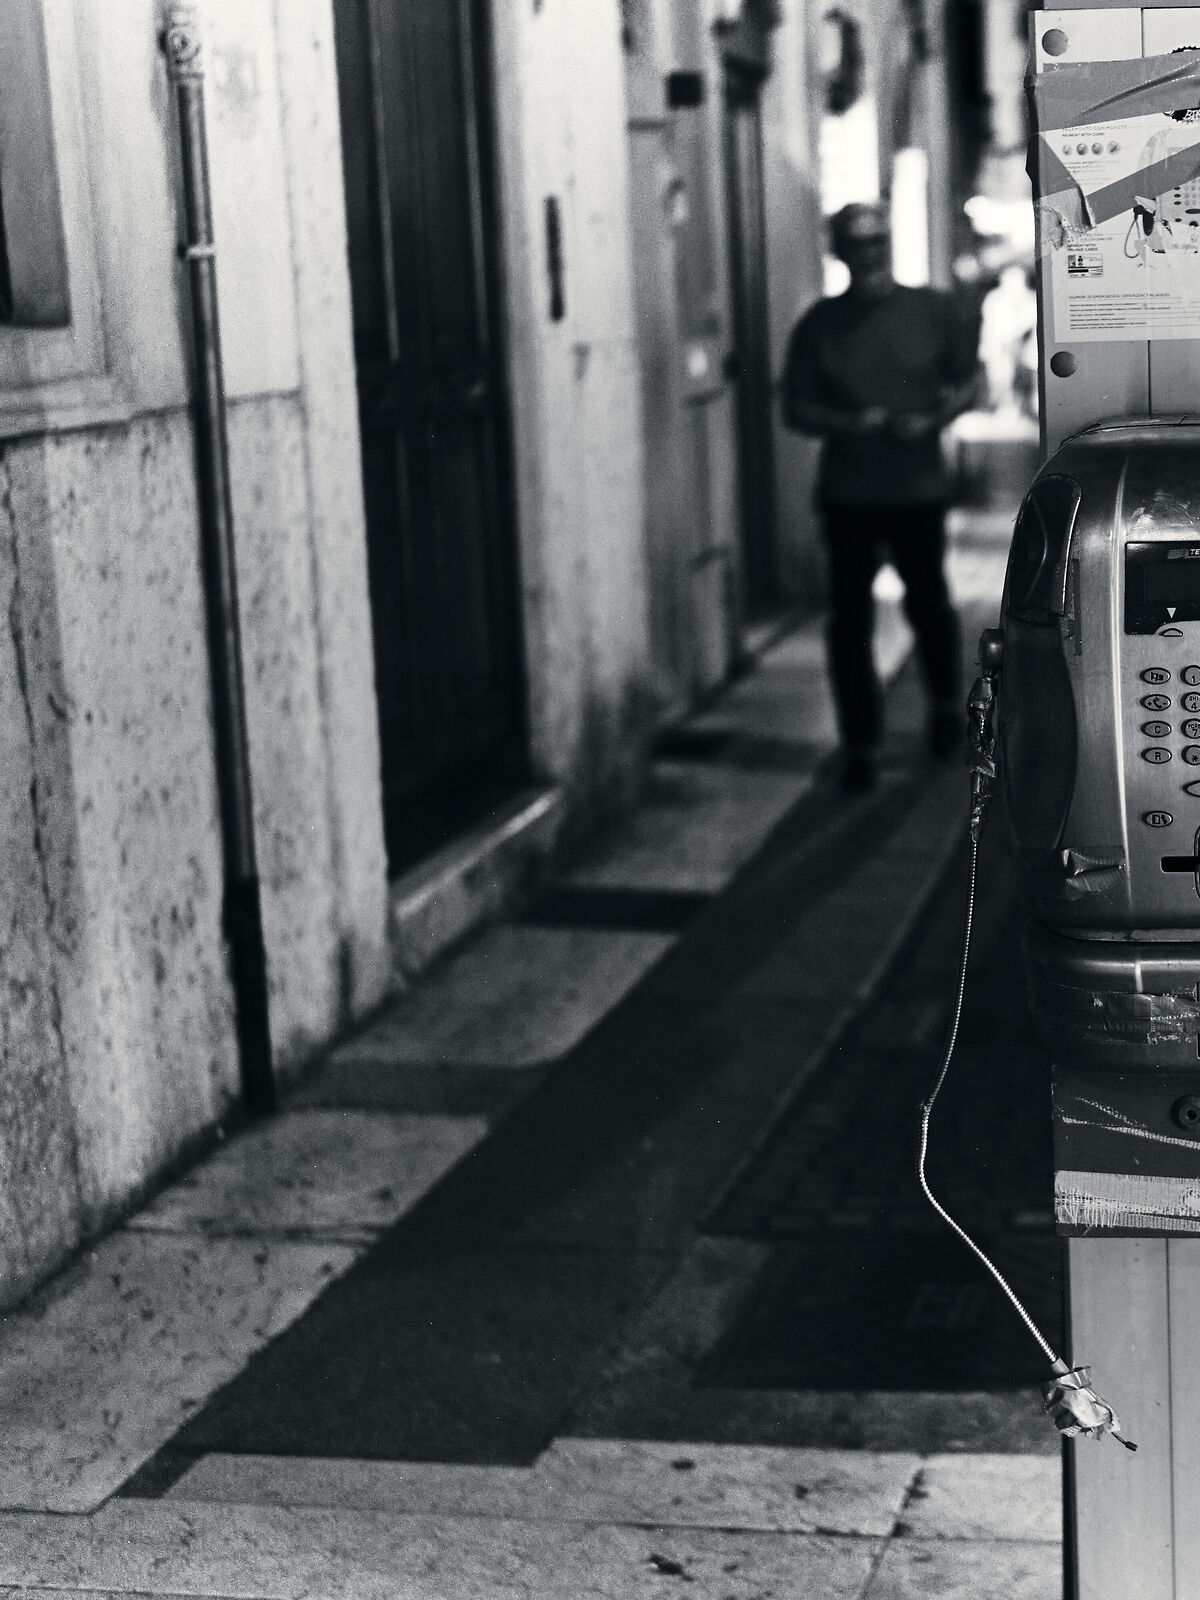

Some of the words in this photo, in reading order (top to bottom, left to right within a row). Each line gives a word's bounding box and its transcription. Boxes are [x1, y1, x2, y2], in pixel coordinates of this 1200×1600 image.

[1191, 702, 1197, 710] 4
[1154, 725, 1161, 734] C
[1154, 752, 1161, 760] R
